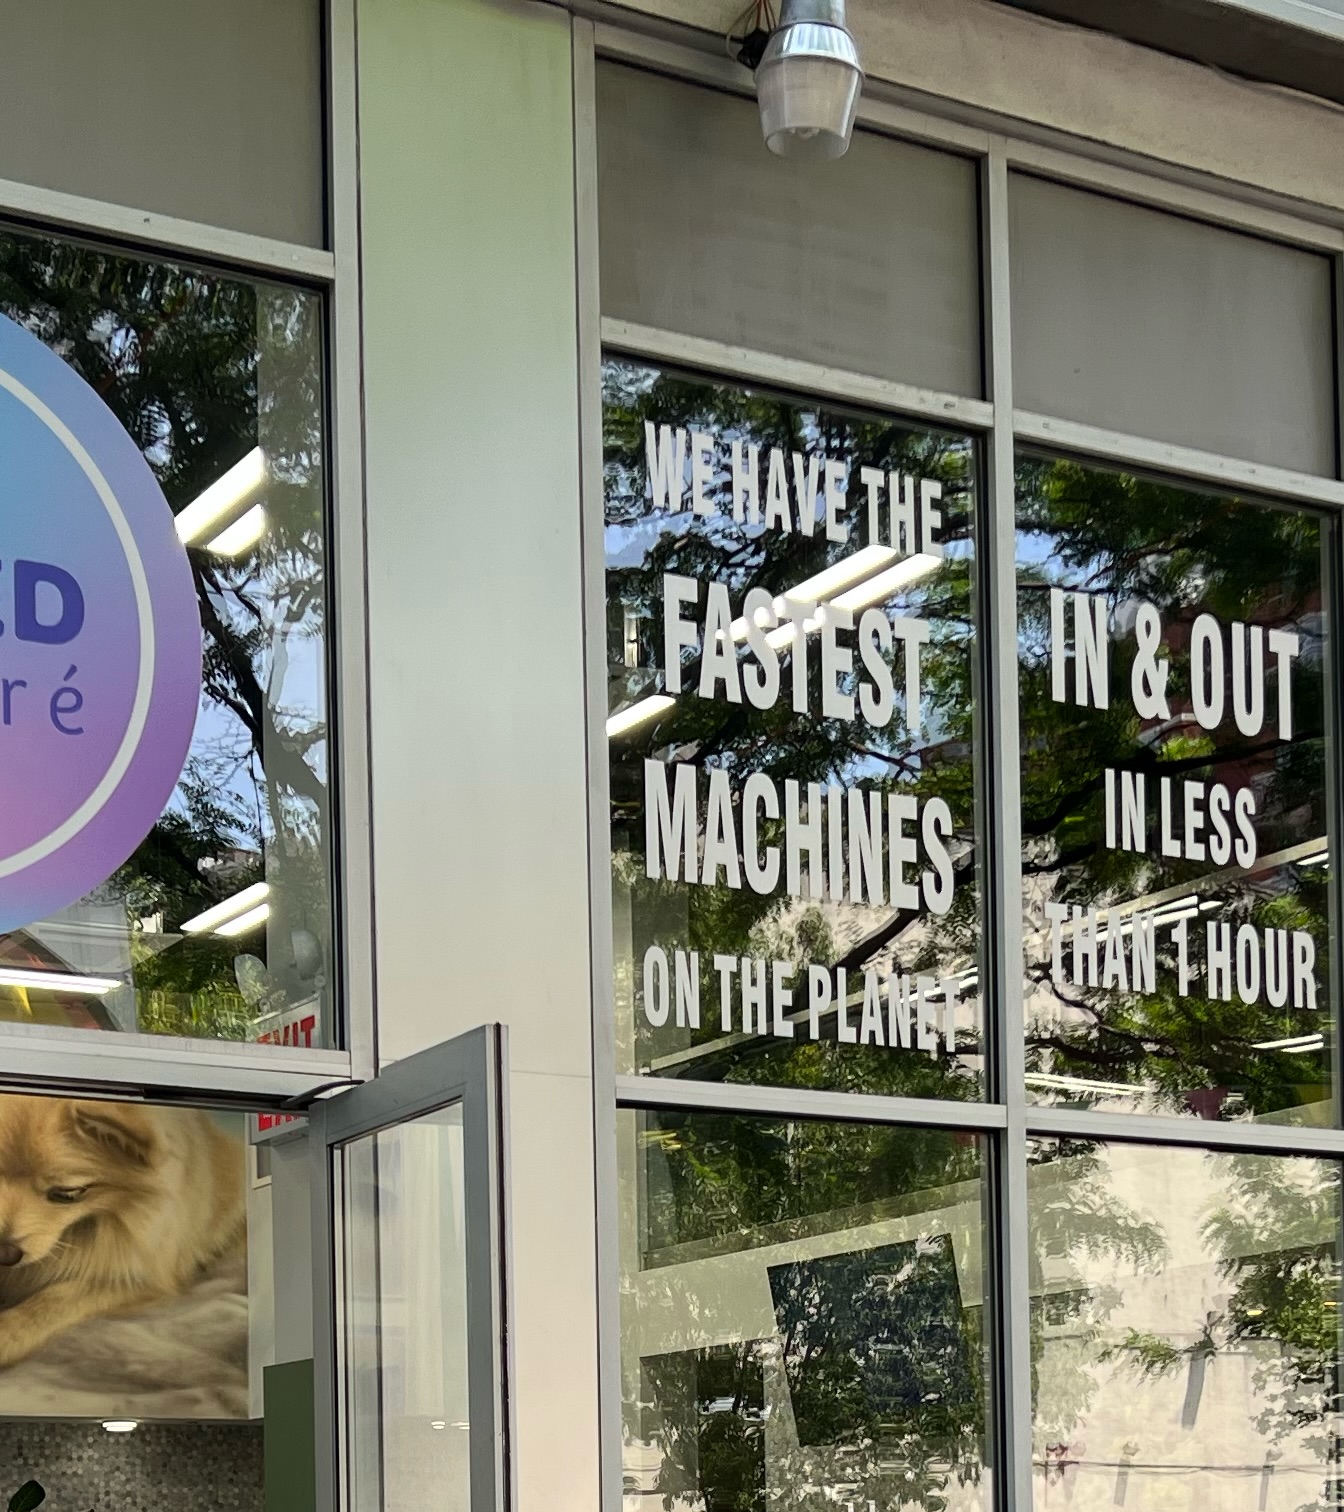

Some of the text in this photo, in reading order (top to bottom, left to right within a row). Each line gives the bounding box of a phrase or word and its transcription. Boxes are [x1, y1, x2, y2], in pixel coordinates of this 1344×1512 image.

[644, 420, 943, 555] WE HAVE THE
[663, 573, 930, 731] FASTEST
[1050, 588, 1299, 741] IN & OUT
[644, 758, 955, 915] MACHINES
[1105, 769, 1256, 869] IN LESS
[643, 945, 960, 1054] ON THE PLANET
[1044, 901, 1317, 1009] THAN 1 HOUR
